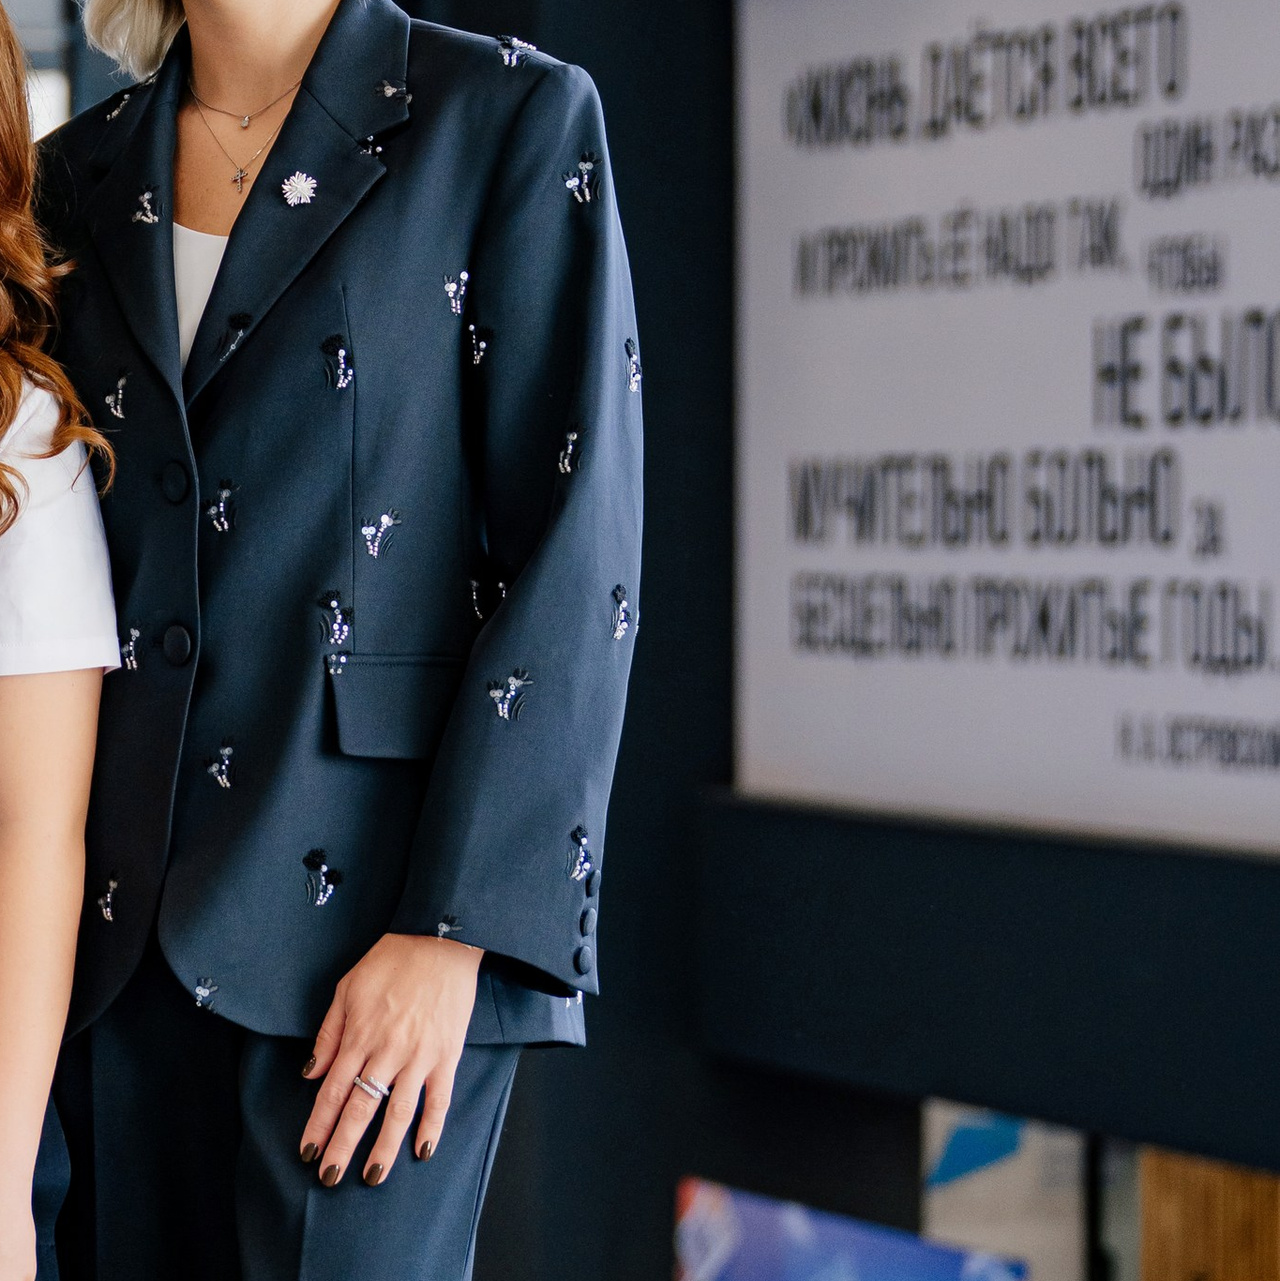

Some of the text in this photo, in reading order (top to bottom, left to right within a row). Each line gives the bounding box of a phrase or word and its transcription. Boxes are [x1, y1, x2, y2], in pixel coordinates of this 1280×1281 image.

[1066, 0, 1188, 114] ВСЕГО
[1091, 310, 1151, 431] НЕ
[1023, 446, 1184, 550] БОЛЬНО
